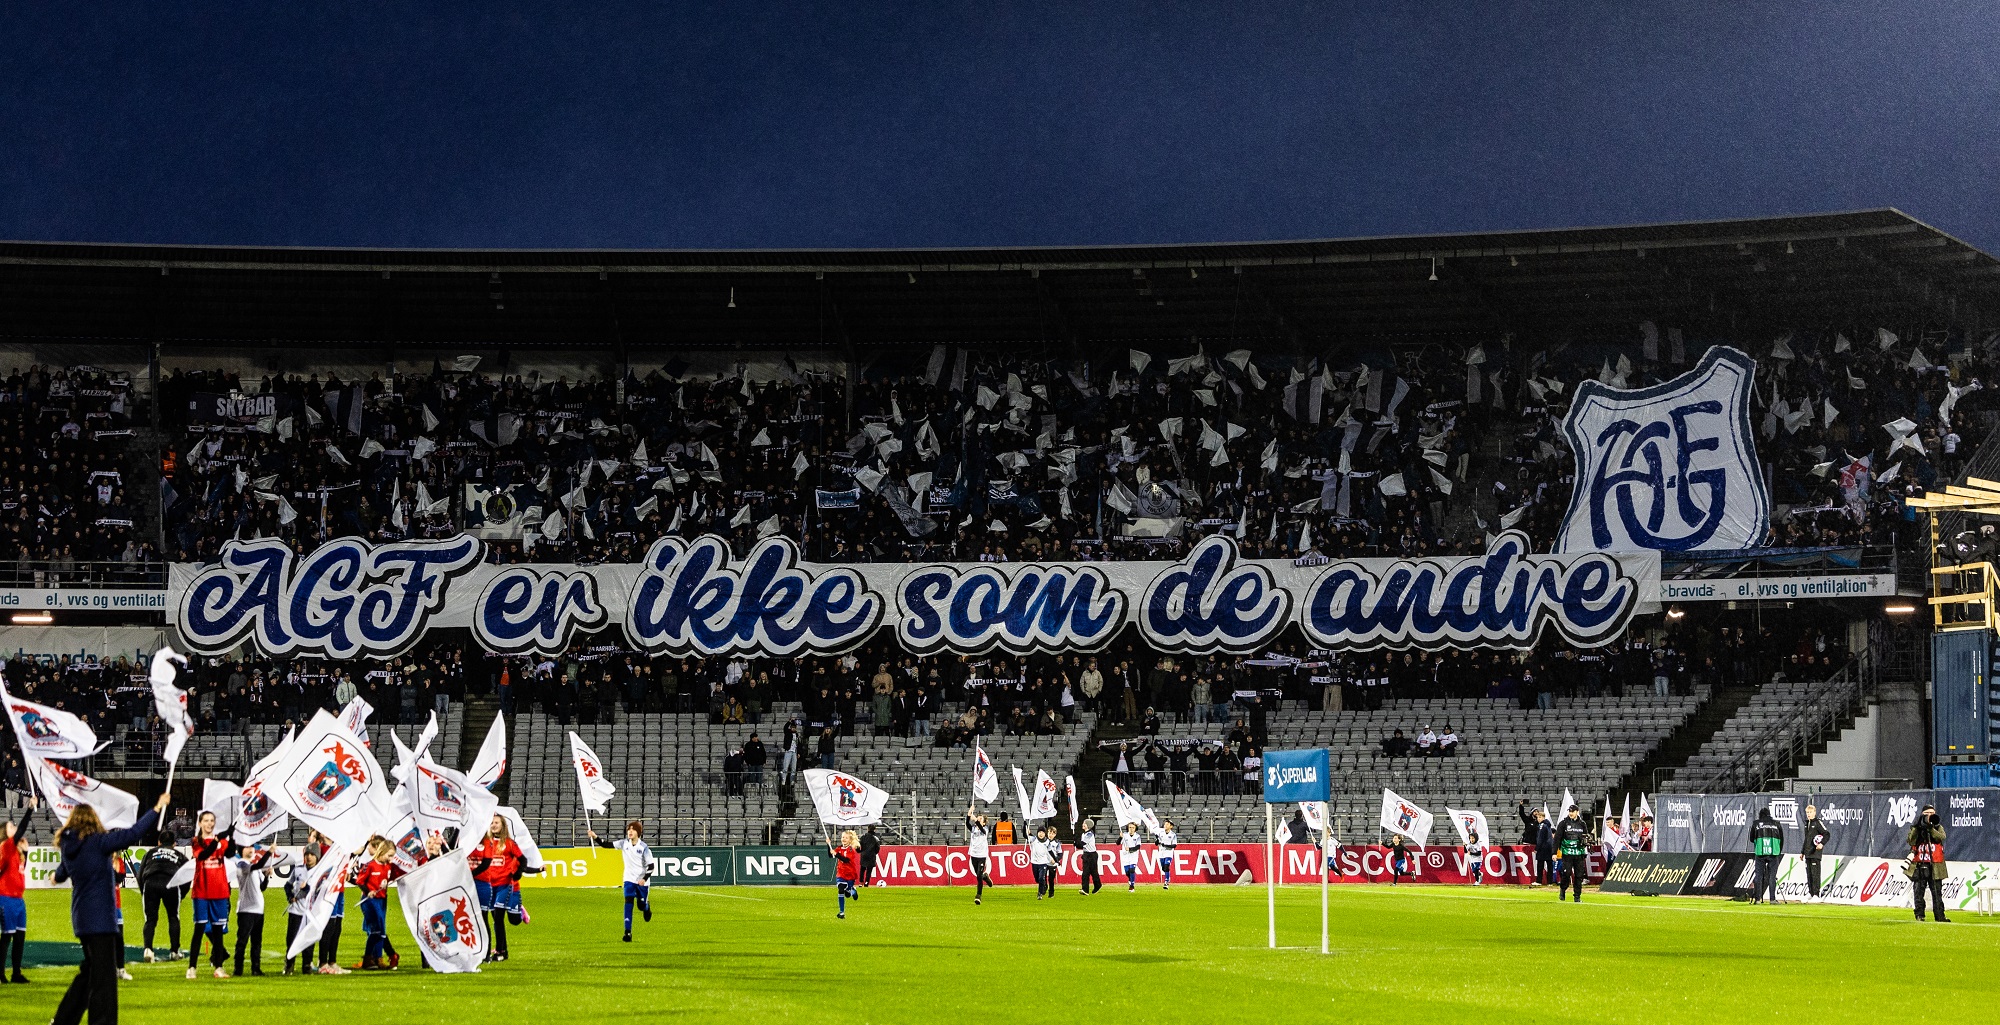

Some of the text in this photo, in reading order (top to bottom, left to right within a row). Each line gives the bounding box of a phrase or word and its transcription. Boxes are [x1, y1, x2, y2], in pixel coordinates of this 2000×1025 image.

[216, 396, 276, 417] SKYBAR
[185, 536, 1628, 654] AGF er ikke som de andre
[1668, 578, 1867, 598] bravida el, vvs og ventilation
[46, 592, 63, 608] el,
[67, 595, 89, 606] vvs
[93, 595, 109, 609] og
[113, 592, 165, 607] ventilati
[1281, 765, 1317, 784] SUPERLIGA
[1774, 802, 1793, 819] CERES
[1949, 794, 1985, 812] Arbejdernes
[1720, 803, 1747, 826] bravida
[1820, 802, 1864, 826] salling group
[1951, 812, 1983, 828] Landsbank
[745, 855, 821, 876] NRGi
[1605, 861, 1689, 888] Billund Airport
